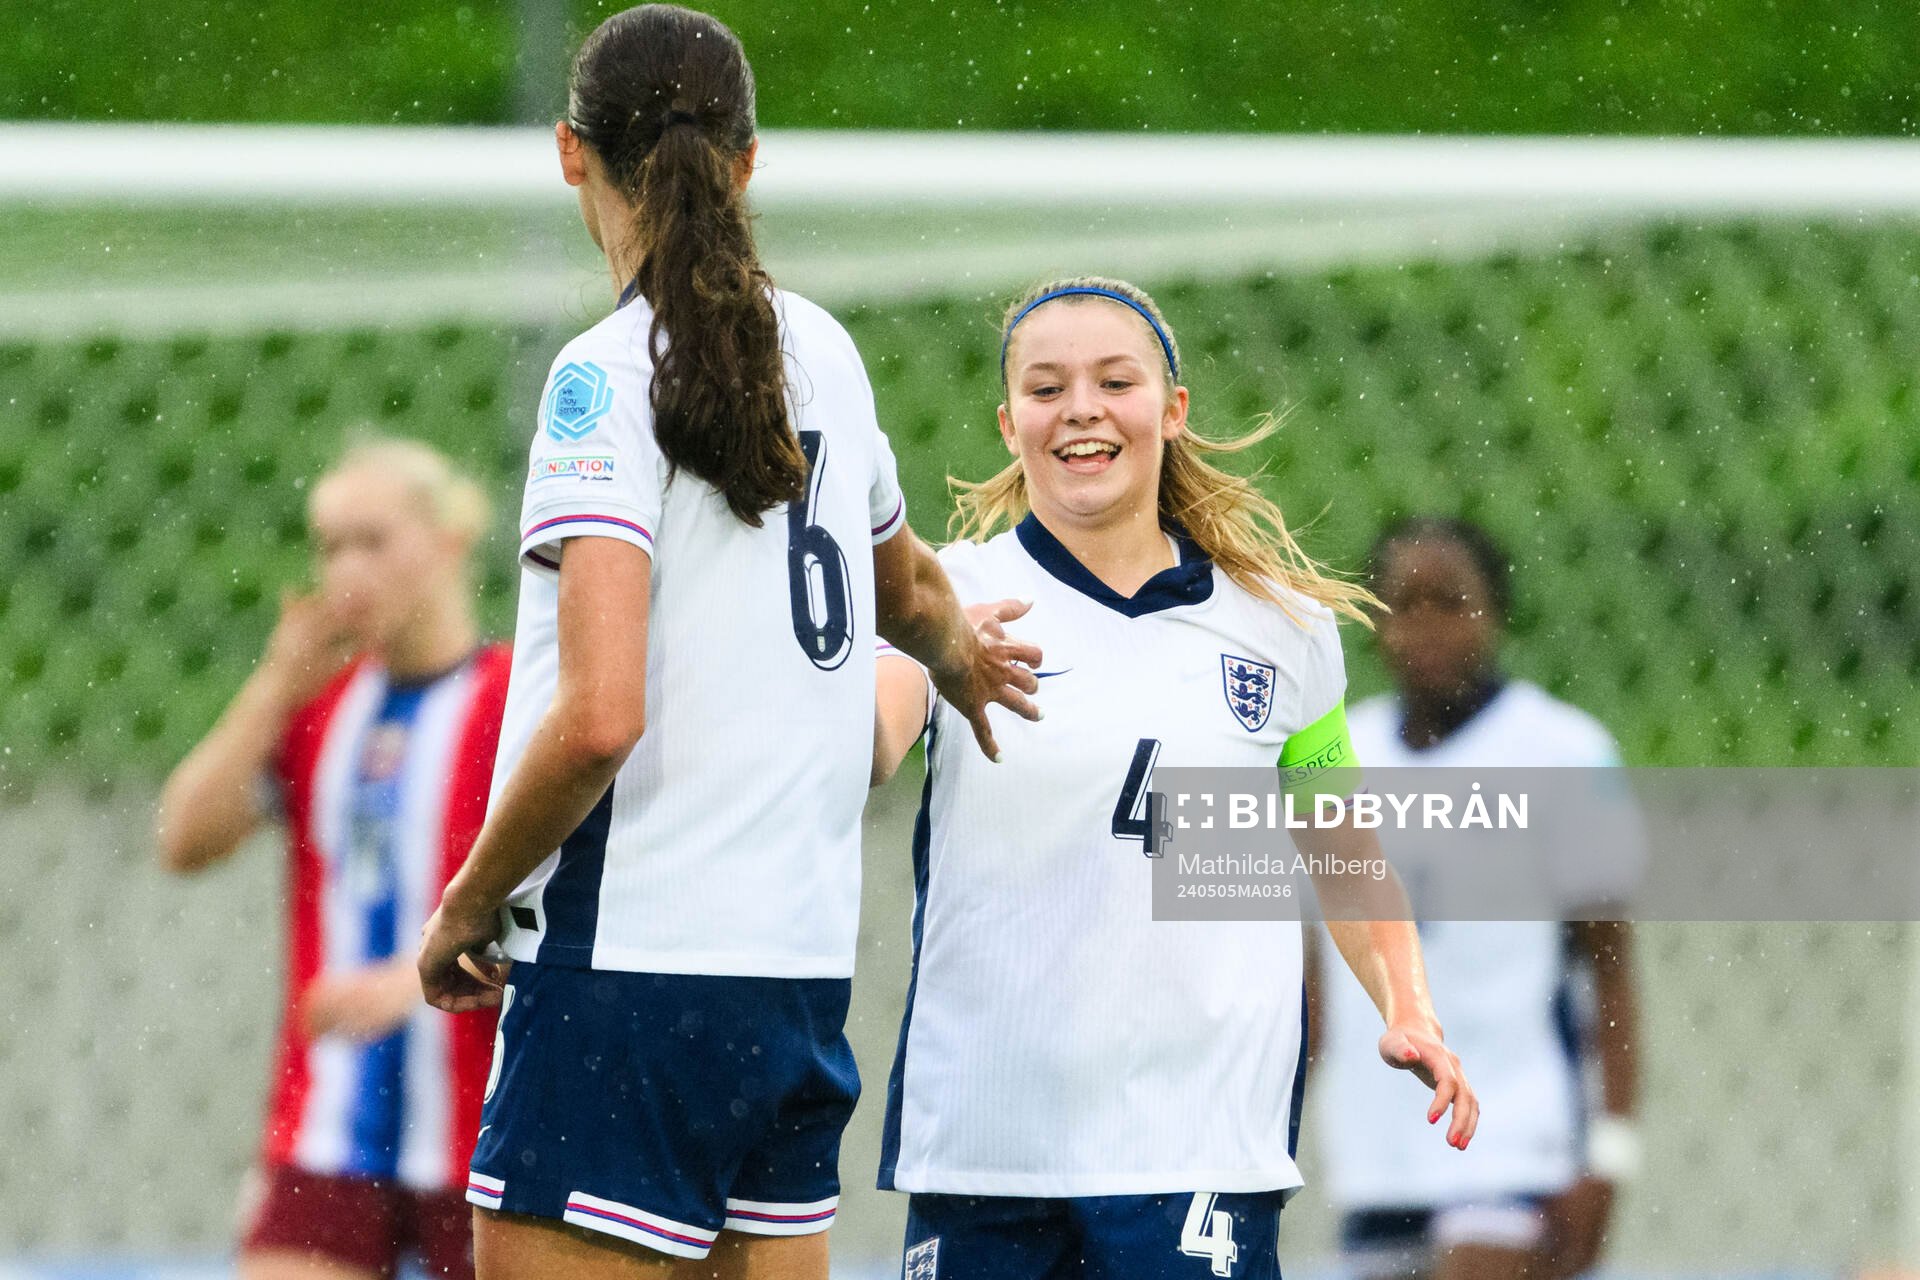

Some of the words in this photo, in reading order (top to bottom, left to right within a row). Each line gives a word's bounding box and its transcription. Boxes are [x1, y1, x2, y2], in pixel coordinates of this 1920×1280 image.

[788, 430, 853, 671] 6
[1111, 738, 1173, 858] 4
[1282, 741, 1343, 784] ESPECT
[1181, 1192, 1237, 1278] 4
